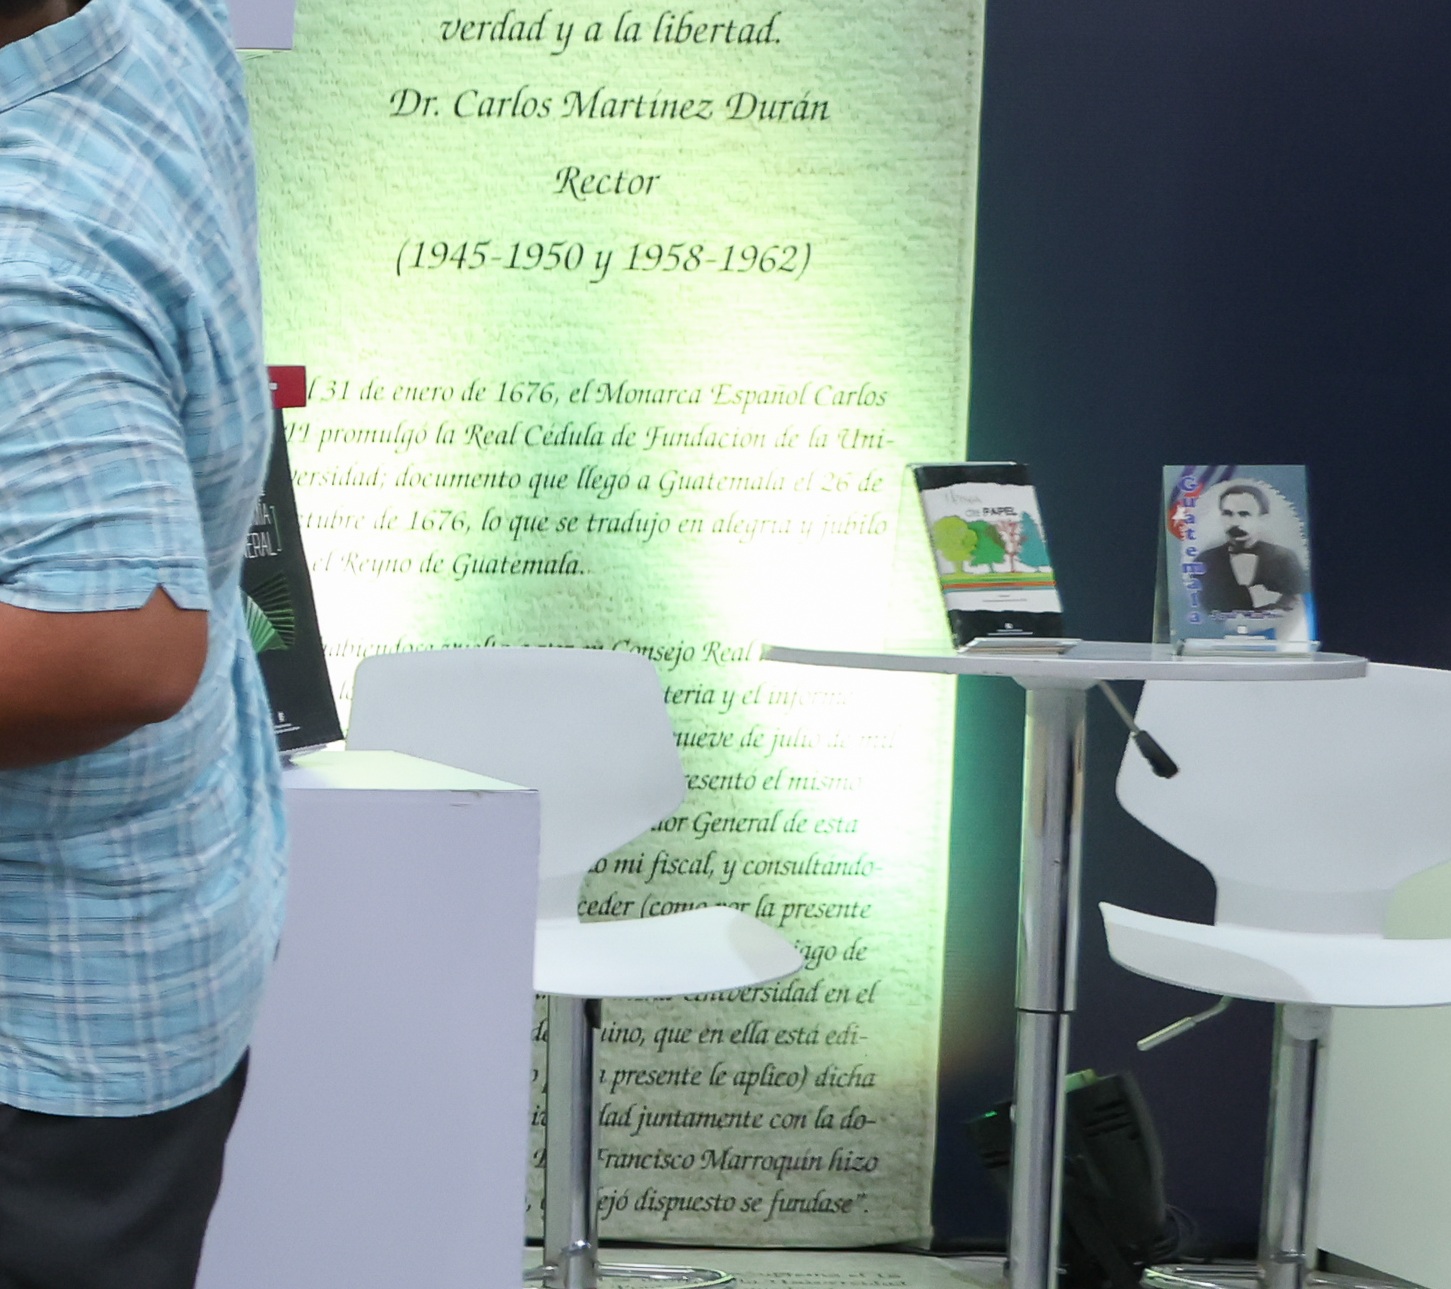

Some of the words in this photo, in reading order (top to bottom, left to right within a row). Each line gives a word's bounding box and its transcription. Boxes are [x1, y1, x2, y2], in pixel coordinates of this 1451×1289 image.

[440, 9, 547, 42] verdad
[550, 22, 574, 56] y
[585, 22, 602, 42] a
[614, 10, 641, 42] la
[653, 10, 782, 44] libertad.
[390, 88, 438, 116] Dr.
[454, 85, 552, 118] Carlos
[562, 86, 713, 120] Martínez
[726, 91, 830, 121] Durán
[554, 166, 660, 200] Rector
[397, 240, 584, 276] (1945-1950
[590, 251, 612, 283] y
[625, 242, 811, 274] 1958-1962)
[595, 381, 703, 408] Monarca
[815, 382, 888, 408] Carlos
[464, 422, 520, 449] Real
[524, 422, 606, 449] Cédula
[395, 464, 521, 492] documento
[528, 469, 568, 498] que
[577, 462, 633, 498] llegó
[586, 508, 671, 539] tradujo
[451, 551, 587, 581] Guatemala.
[701, 1149, 822, 1177] Marroquín
[829, 1146, 879, 1173] hizo
[634, 1189, 736, 1222] dispuesto
